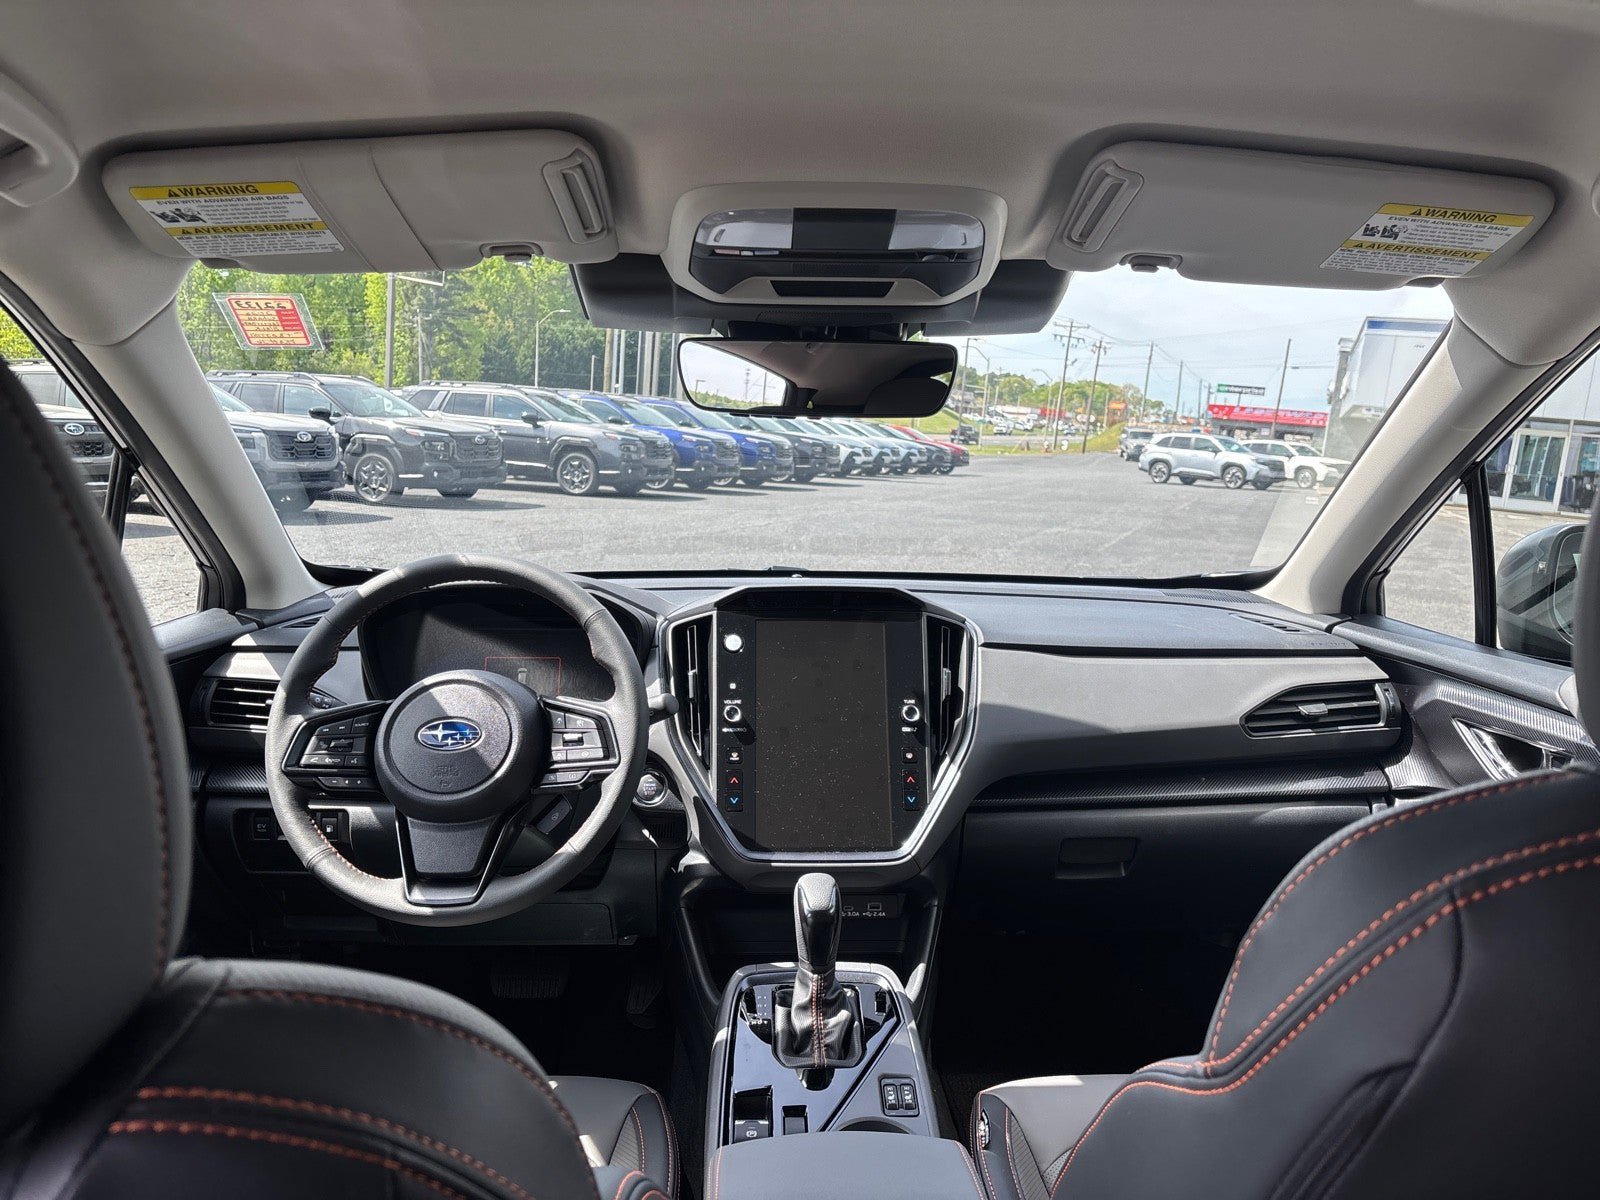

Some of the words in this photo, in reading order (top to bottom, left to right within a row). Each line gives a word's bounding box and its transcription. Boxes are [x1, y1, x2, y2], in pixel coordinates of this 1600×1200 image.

[178, 184, 259, 197] WARNING
[1425, 208, 1497, 222] WARNING
[194, 222, 313, 234] AVERTISSEMENT
[1431, 220, 1472, 228] ADVANCED
[1365, 243, 1480, 258] AVERTISSEMENT
